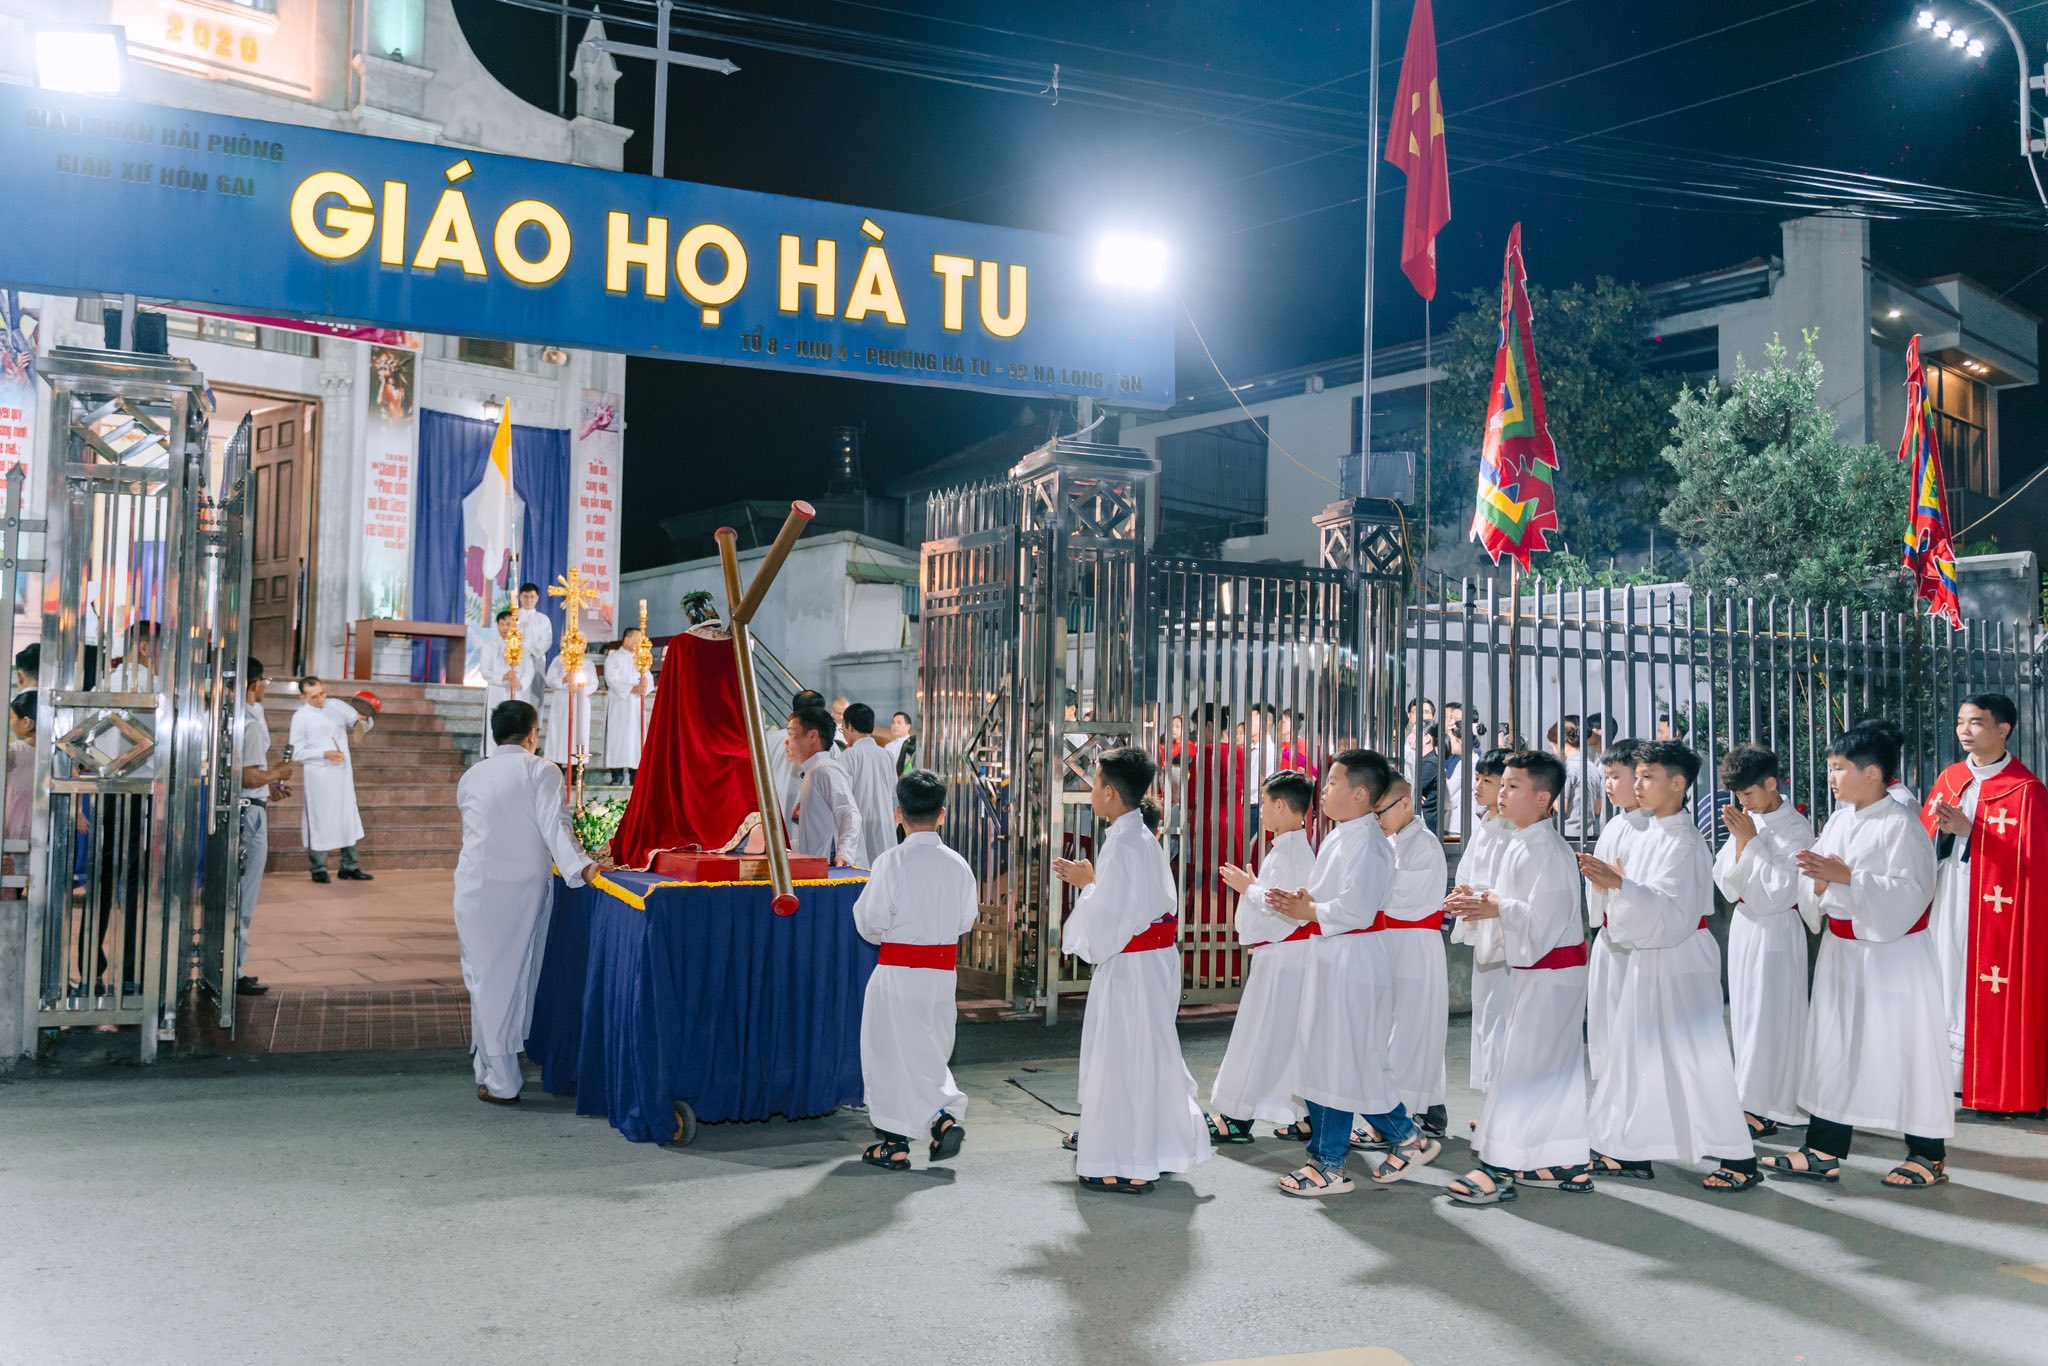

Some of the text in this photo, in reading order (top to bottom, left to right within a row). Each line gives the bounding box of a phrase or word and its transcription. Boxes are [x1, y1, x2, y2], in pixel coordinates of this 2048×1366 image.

[165, 12, 259, 64] 2020
[207, 132, 285, 163] PHÒNG
[57, 151, 112, 180] GIÁO
[216, 174, 256, 199] GAI
[290, 158, 1028, 338] GIÁO HỌ HÀ TU
[740, 324, 763, 353] TỔ
[767, 336, 778, 355] 8
[796, 339, 833, 361] KHU
[837, 342, 849, 362] 4
[941, 352, 964, 375] HÀ
[969, 357, 991, 377] TU
[1033, 364, 1056, 387] HẠ
[1061, 368, 1104, 389] LONG
[1119, 373, 1142, 393] QN
